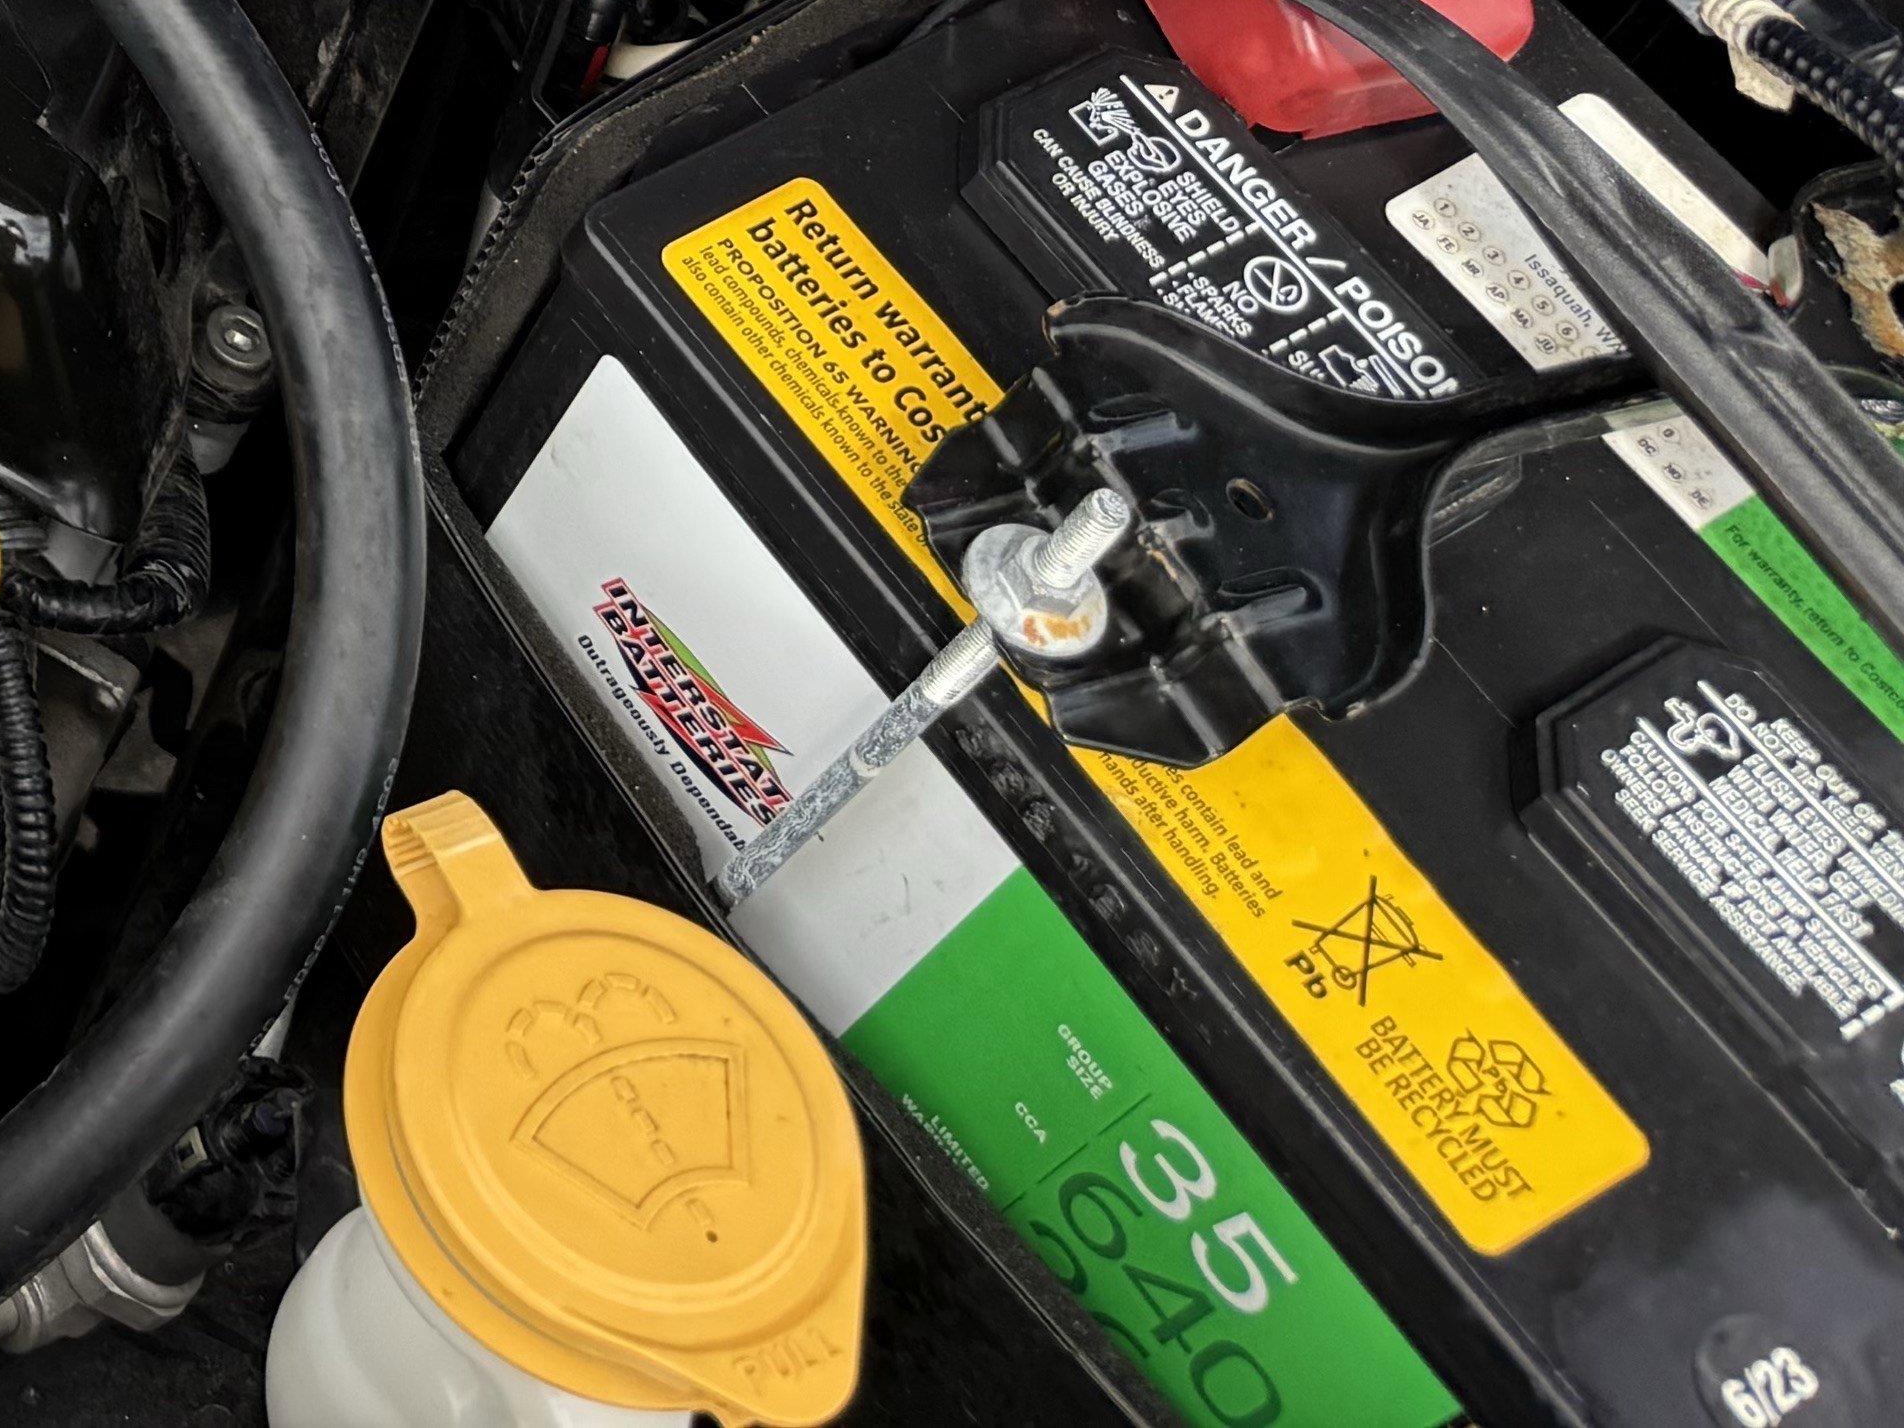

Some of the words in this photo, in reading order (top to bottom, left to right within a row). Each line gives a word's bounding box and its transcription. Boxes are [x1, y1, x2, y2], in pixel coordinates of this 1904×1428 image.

[1030, 127, 1063, 157] CAN
[1056, 155, 1102, 199] CAUSE
[1093, 197, 1165, 269] BLINDNESS
[1050, 173, 1076, 196] OR
[1069, 194, 1119, 242] INJURY
[1085, 158, 1146, 218] GASES
[1103, 149, 1196, 244] EXPLOSIVE
[1157, 179, 1206, 226] EYES
[1173, 108, 1319, 251] DANGER
[1173, 170, 1239, 235] SHIELD
[716, 237, 826, 358] PROPOSITION
[820, 360, 849, 385] 65
[745, 216, 873, 347] batteries
[858, 350, 900, 383] to
[783, 198, 884, 299] Return
[872, 300, 992, 422] warrant
[1191, 274, 1254, 337] SPARKS
[1220, 281, 1260, 317] NO
[1520, 253, 1597, 330] Issaquah,
[680, 253, 710, 280] also
[702, 278, 749, 325] contain
[741, 325, 776, 358] other
[768, 357, 828, 419] chemicals
[819, 417, 859, 457] known
[851, 456, 874, 476] to
[868, 476, 894, 498] the
[886, 497, 920, 531] state
[698, 245, 729, 273] lead
[719, 273, 791, 347] compounds,
[782, 345, 841, 406] chemicals
[834, 406, 873, 443] known
[866, 444, 889, 464] to
[884, 464, 910, 487] the
[1723, 523, 1751, 548] For
[1746, 550, 1807, 609] warranty,
[1802, 606, 1845, 647] return
[1843, 646, 1863, 662] to
[573, 634, 672, 759] Outrageously
[667, 760, 746, 853] Dependab
[599, 606, 777, 827] BATTERIES
[1723, 693, 1756, 723] DO
[1749, 722, 1791, 761] NOT
[1820, 795, 1872, 845] KEEP
[1768, 718, 1819, 767] KEEP
[1812, 764, 1855, 804] OUT
[1849, 802, 1884, 835] OF
[1132, 792, 1170, 829] after
[1158, 828, 1226, 899] handling.
[1172, 809, 1216, 853] harm.
[1208, 852, 1269, 917] Batteries
[1177, 781, 1231, 837] contain
[1222, 835, 1254, 864] lead
[1245, 862, 1282, 899] and
[1598, 747, 1666, 814] OWNERS
[1736, 899, 1778, 938] NOT
[1612, 788, 1657, 831] SEEK
[1649, 829, 1717, 896] SERVICE
[1707, 776, 1783, 851] MEDICAL
[1774, 848, 1825, 897] HELP
[1819, 892, 1872, 942] FAST
[1725, 765, 1774, 812] WITH
[1826, 871, 1870, 912] GET
[1740, 753, 1801, 811] FLUSH
[1793, 807, 1844, 855] EYES
[1619, 743, 1684, 807] FOLLOW
[1674, 805, 1783, 916] INSTRUCTIONS
[1776, 915, 1802, 938] IN
[1795, 935, 1865, 1004] VEHICLE
[1692, 799, 1728, 833] FOR
[1723, 833, 1766, 873] SAFE
[1761, 873, 1808, 918] JUMP
[1803, 917, 1881, 996] STARTING
[1282, 951, 1333, 1000] Pb
[1054, 1022, 1114, 1093] GROUP
[1063, 1054, 1104, 1100] SIZE
[1353, 1036, 1394, 1074] BE
[1382, 1072, 1501, 1204] RECYCLED
[1369, 1015, 1473, 1129] BATTERY
[1456, 1121, 1532, 1201] MUST
[926, 1114, 992, 1192] LIMITED
[1011, 1100, 1049, 1144] CCA
[1107, 1107, 1302, 1324] 35
[1043, 1156, 1292, 1428] 640
[1719, 1346, 1819, 1428] 6/23
